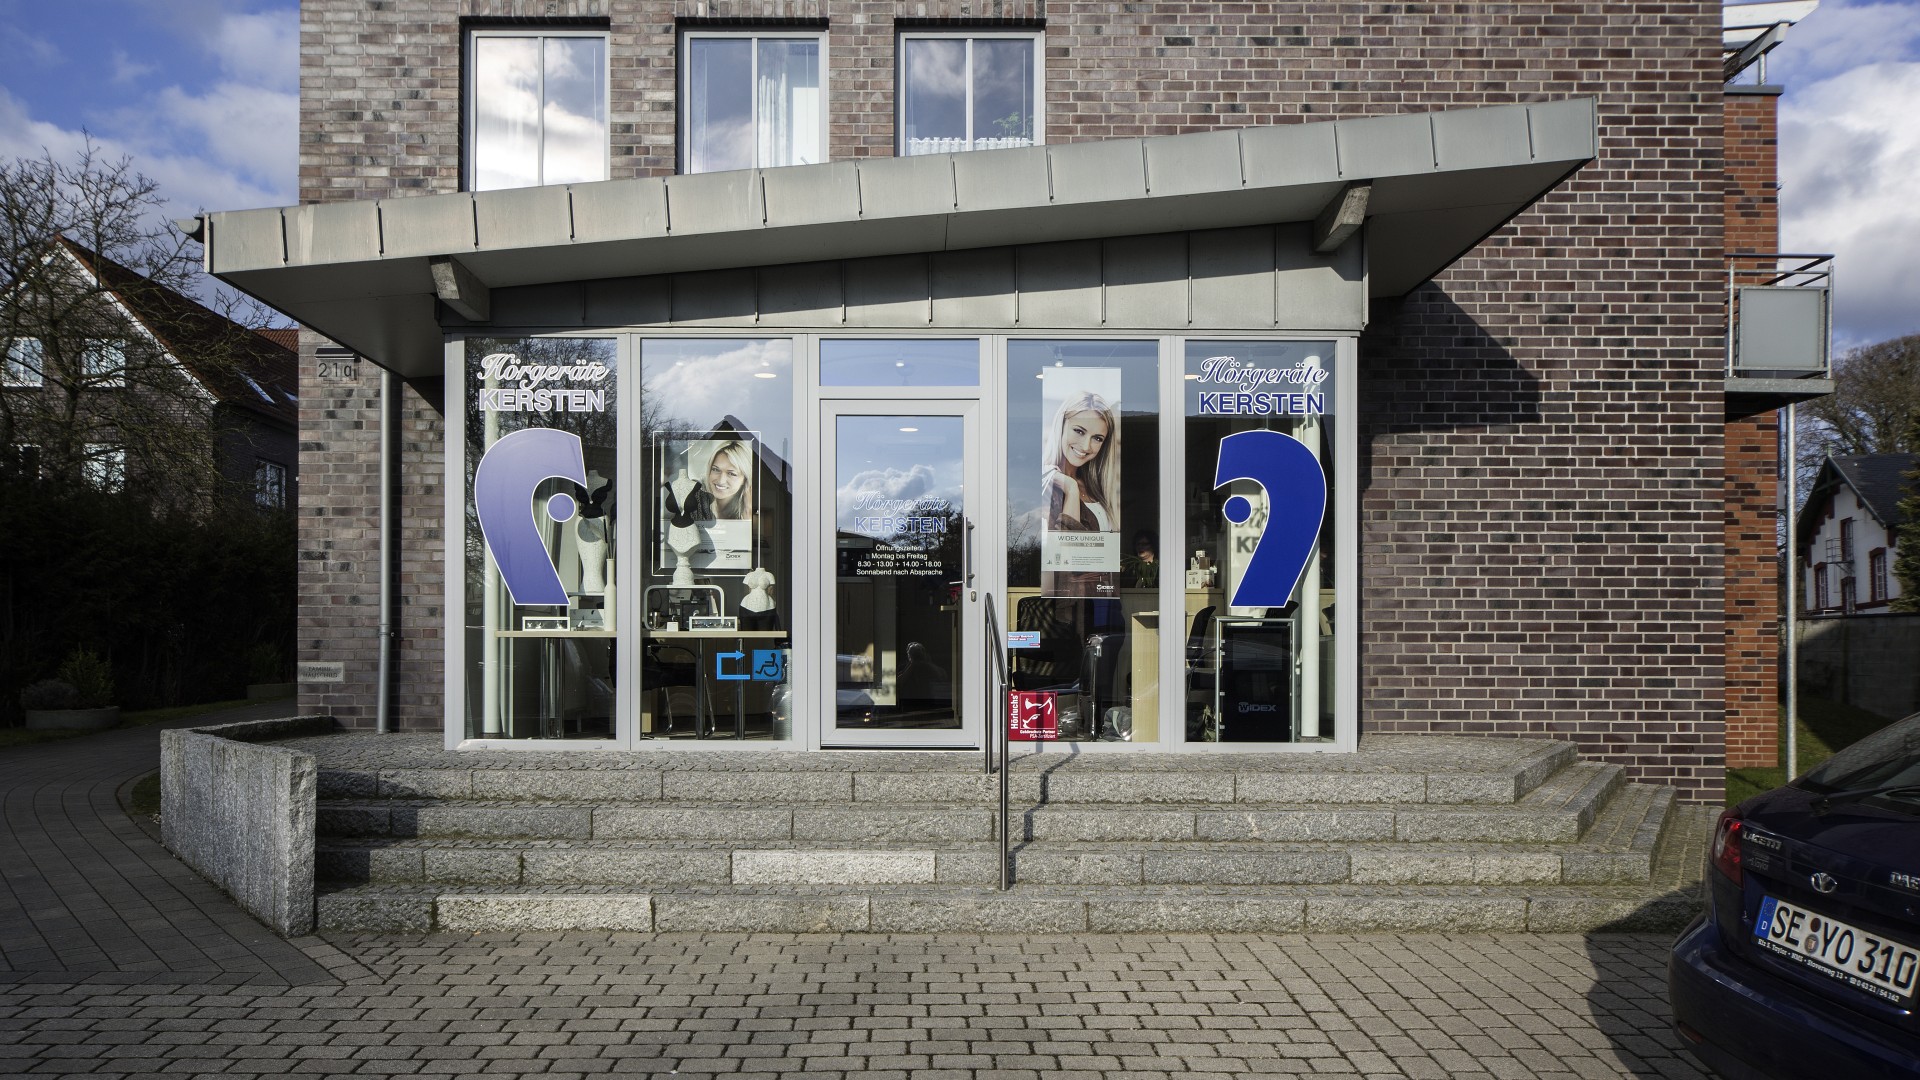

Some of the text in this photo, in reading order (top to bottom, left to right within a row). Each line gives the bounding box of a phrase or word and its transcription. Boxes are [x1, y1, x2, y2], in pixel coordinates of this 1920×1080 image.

[318, 362, 352, 378] 21a
[477, 353, 609, 390] Hörgeräte
[1197, 356, 1329, 393] Hörgeräte
[478, 389, 605, 412] KERSTEN
[1199, 392, 1325, 415] KERSTEN
[853, 490, 949, 517] Hörgeräte
[854, 517, 946, 533] KERSTEN
[1238, 701, 1277, 713] WIDEX
[1761, 921, 1768, 930] D
[1771, 906, 1918, 990] SE YO 310
